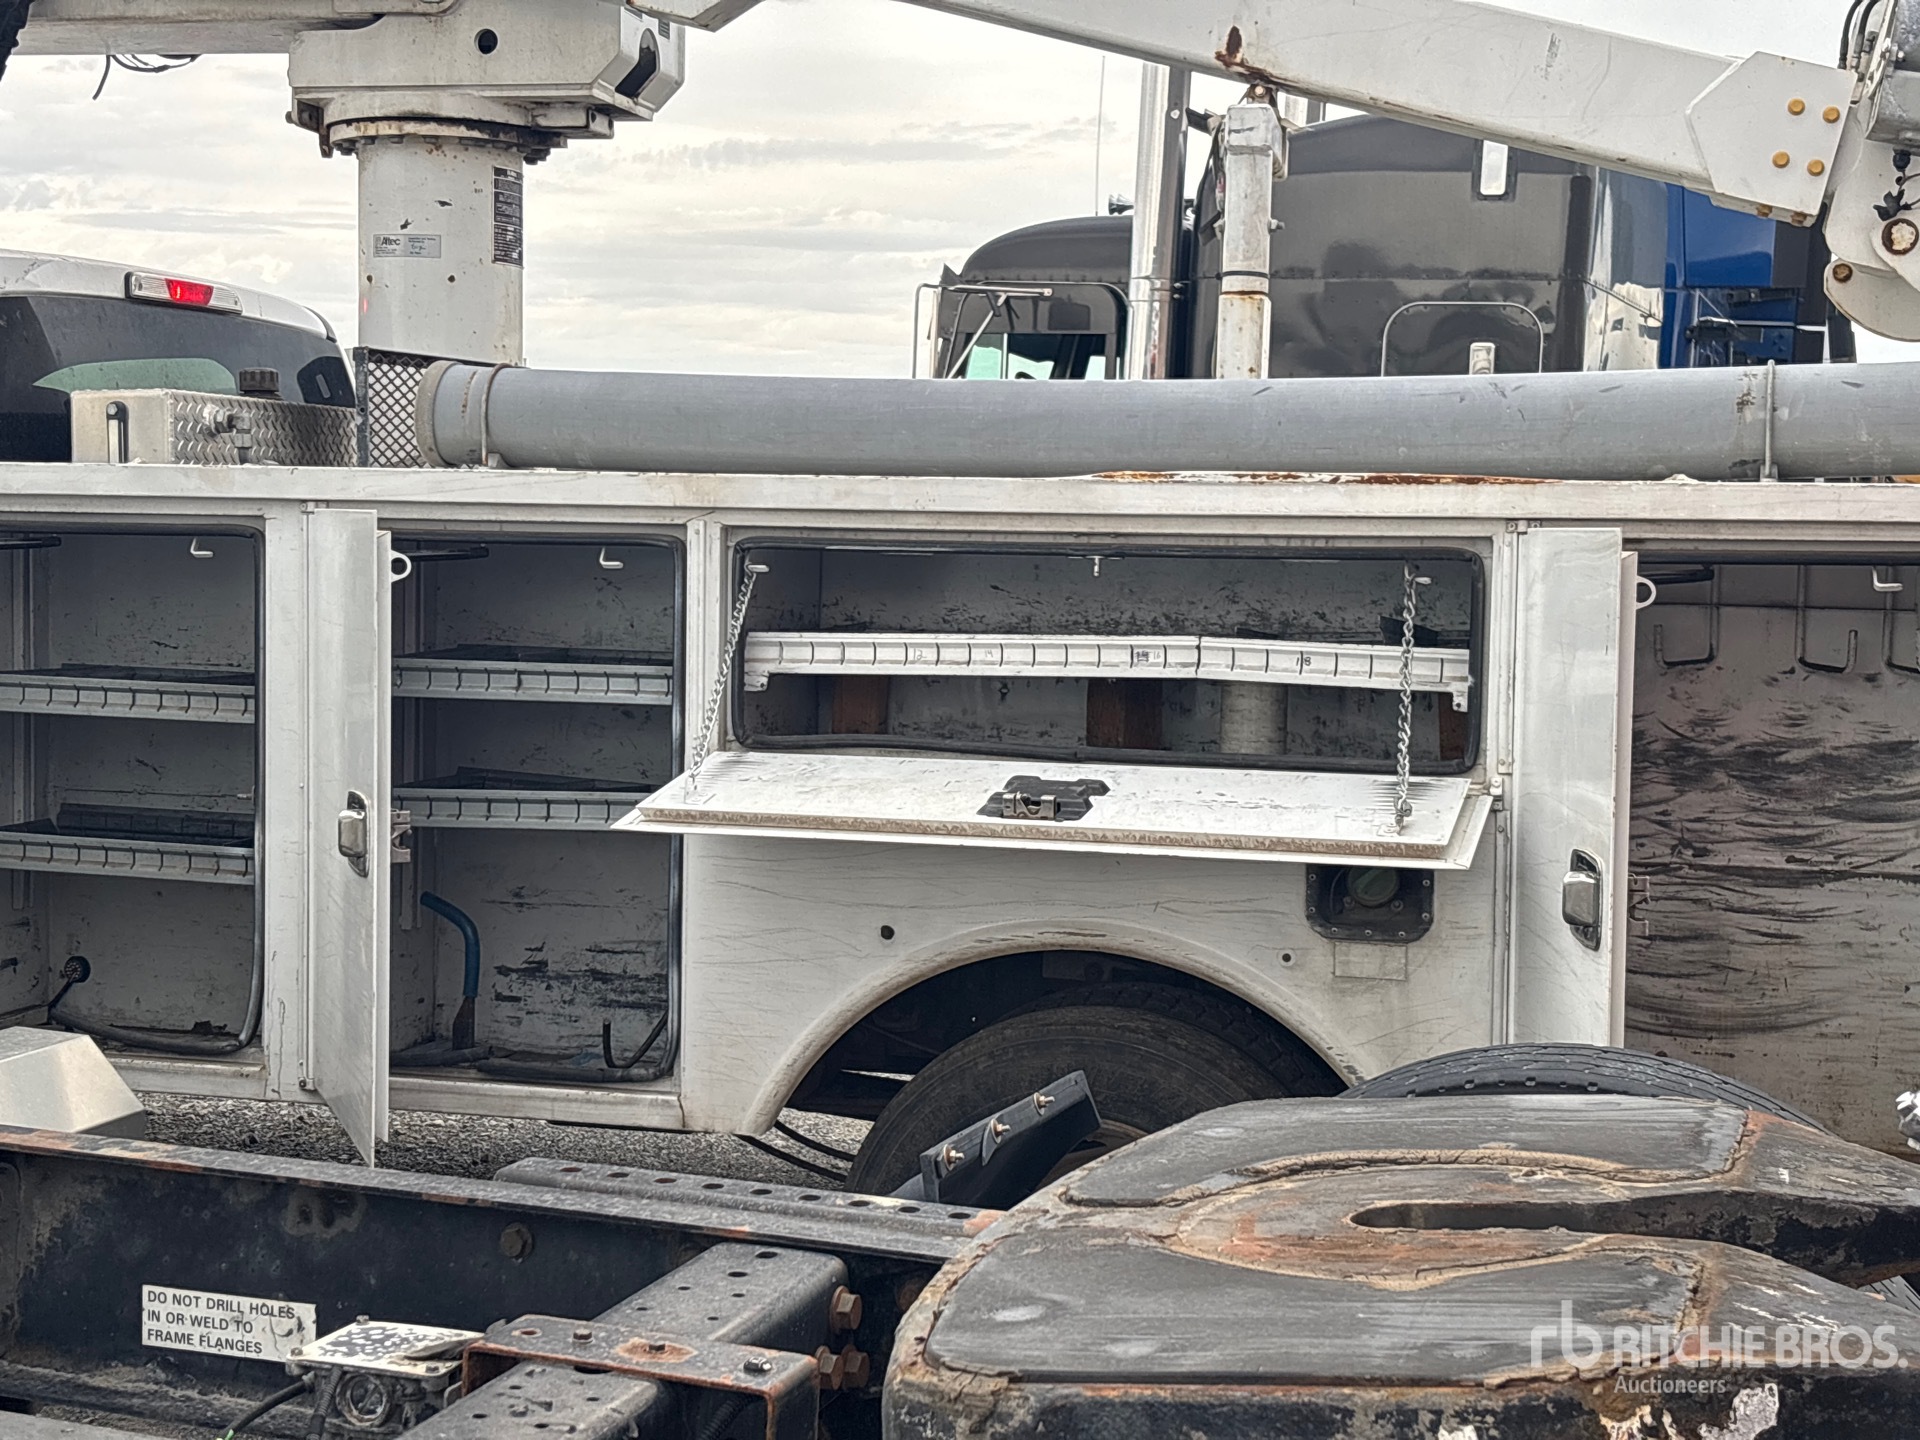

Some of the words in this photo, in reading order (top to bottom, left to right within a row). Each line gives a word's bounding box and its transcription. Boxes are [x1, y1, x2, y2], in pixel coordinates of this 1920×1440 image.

[381, 236, 401, 246] Altec
[147, 1290, 167, 1304] DO
[172, 1293, 201, 1308] NOT
[206, 1297, 244, 1313] DRILL
[249, 1302, 295, 1319] HOLES
[147, 1309, 161, 1323] IN
[166, 1311, 185, 1325] OR
[190, 1314, 229, 1331] WELD
[234, 1320, 253, 1334] TO
[147, 1328, 195, 1345] FRAME
[199, 1335, 263, 1354] FLANGES
